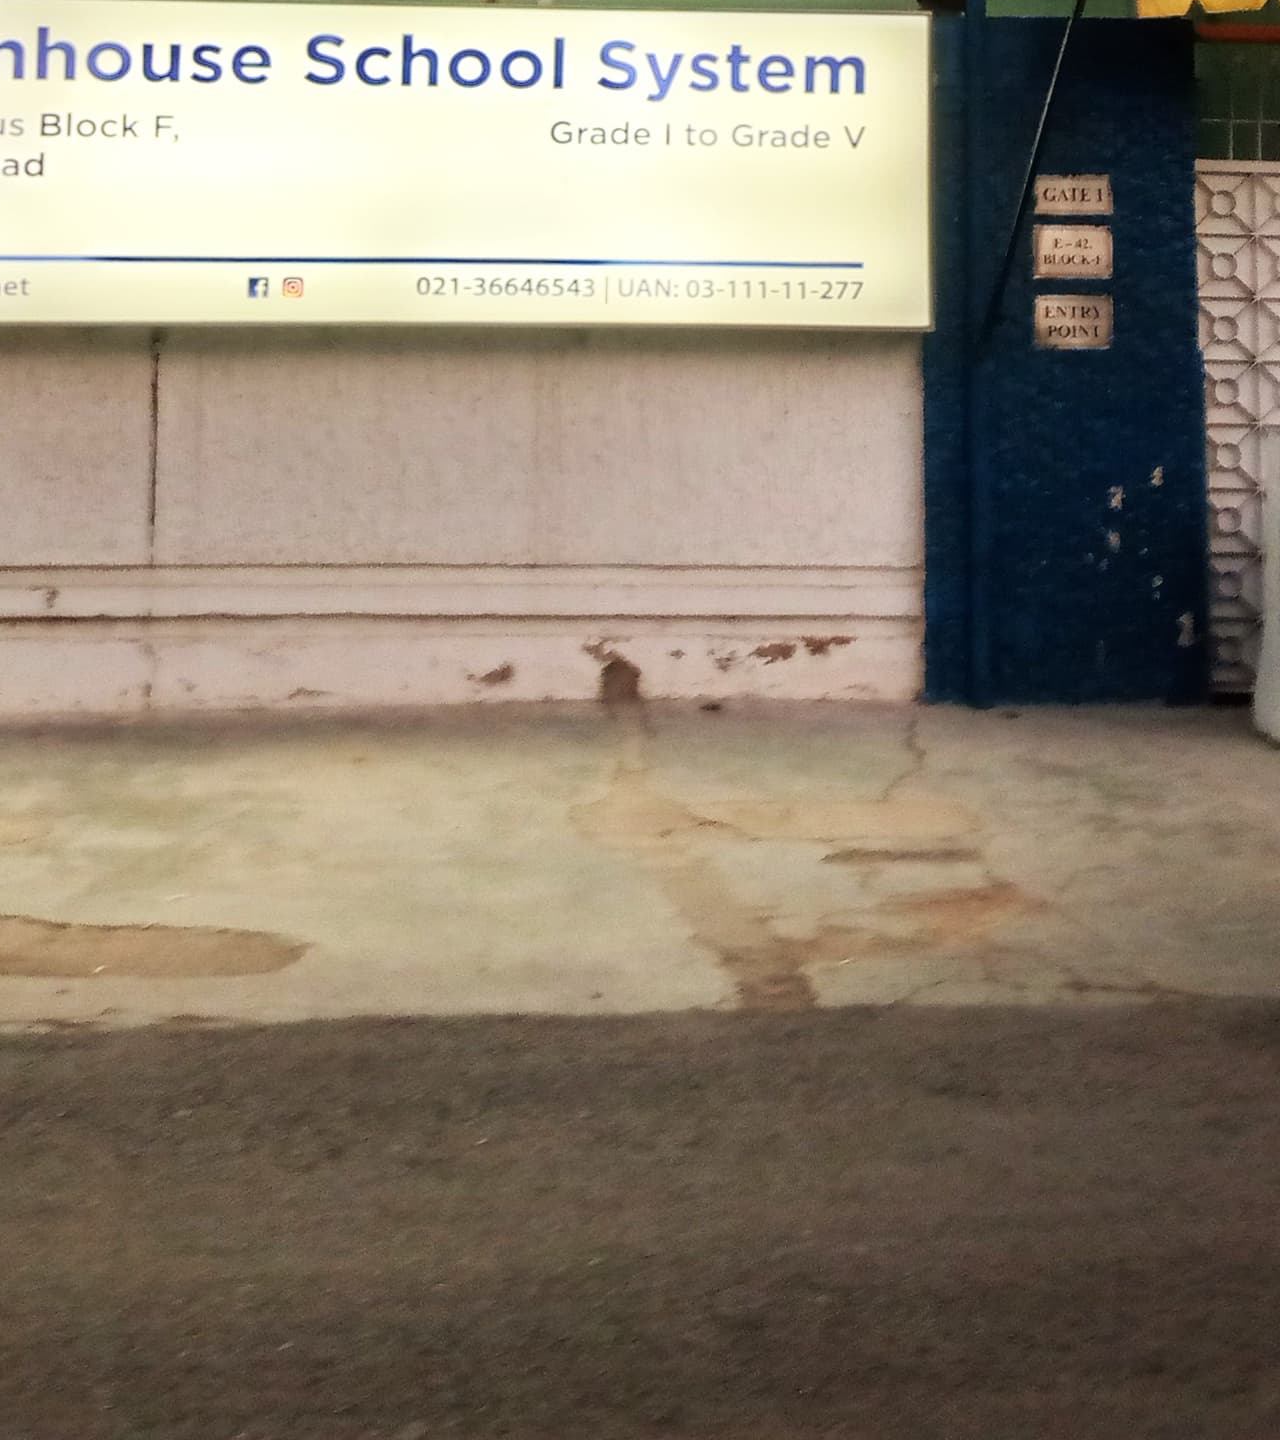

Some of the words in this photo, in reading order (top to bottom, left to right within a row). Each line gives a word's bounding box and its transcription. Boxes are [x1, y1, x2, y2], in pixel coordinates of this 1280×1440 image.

[303, 33, 566, 90] School
[596, 39, 867, 103] System
[39, 112, 138, 139] Block
[549, 119, 652, 147] Grade
[664, 122, 672, 147] I
[685, 124, 719, 148] to
[730, 122, 832, 149] Grade
[843, 124, 867, 150] V
[1042, 186, 1091, 203] GATE
[416, 275, 596, 299] 021-36646543
[617, 277, 679, 300] UAN:
[686, 278, 864, 302] 03-111-11-277
[1044, 304, 1101, 320] ENTRY
[1047, 324, 1100, 339] POINT
